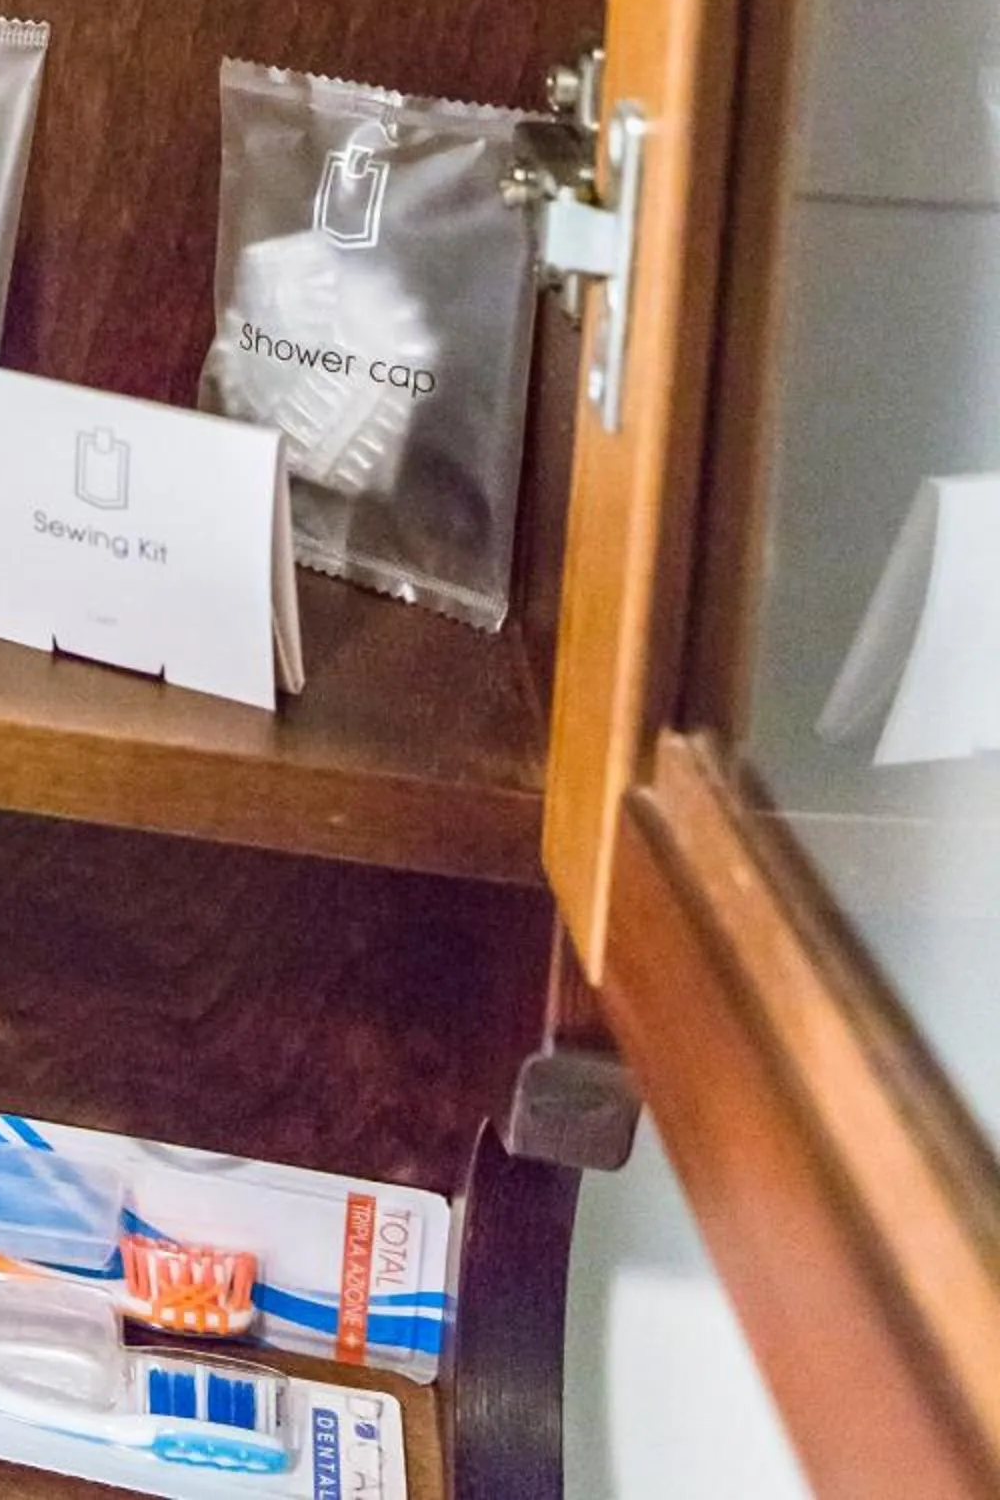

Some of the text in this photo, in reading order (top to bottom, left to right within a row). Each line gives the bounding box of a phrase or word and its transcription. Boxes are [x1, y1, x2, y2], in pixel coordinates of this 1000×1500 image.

[239, 323, 435, 398] Shower cap
[33, 509, 168, 564] Sewing Kit
[346, 1203, 371, 1257] TRIPLA
[375, 1208, 411, 1288] TOTAL
[315, 1416, 338, 1500] DENTAL
